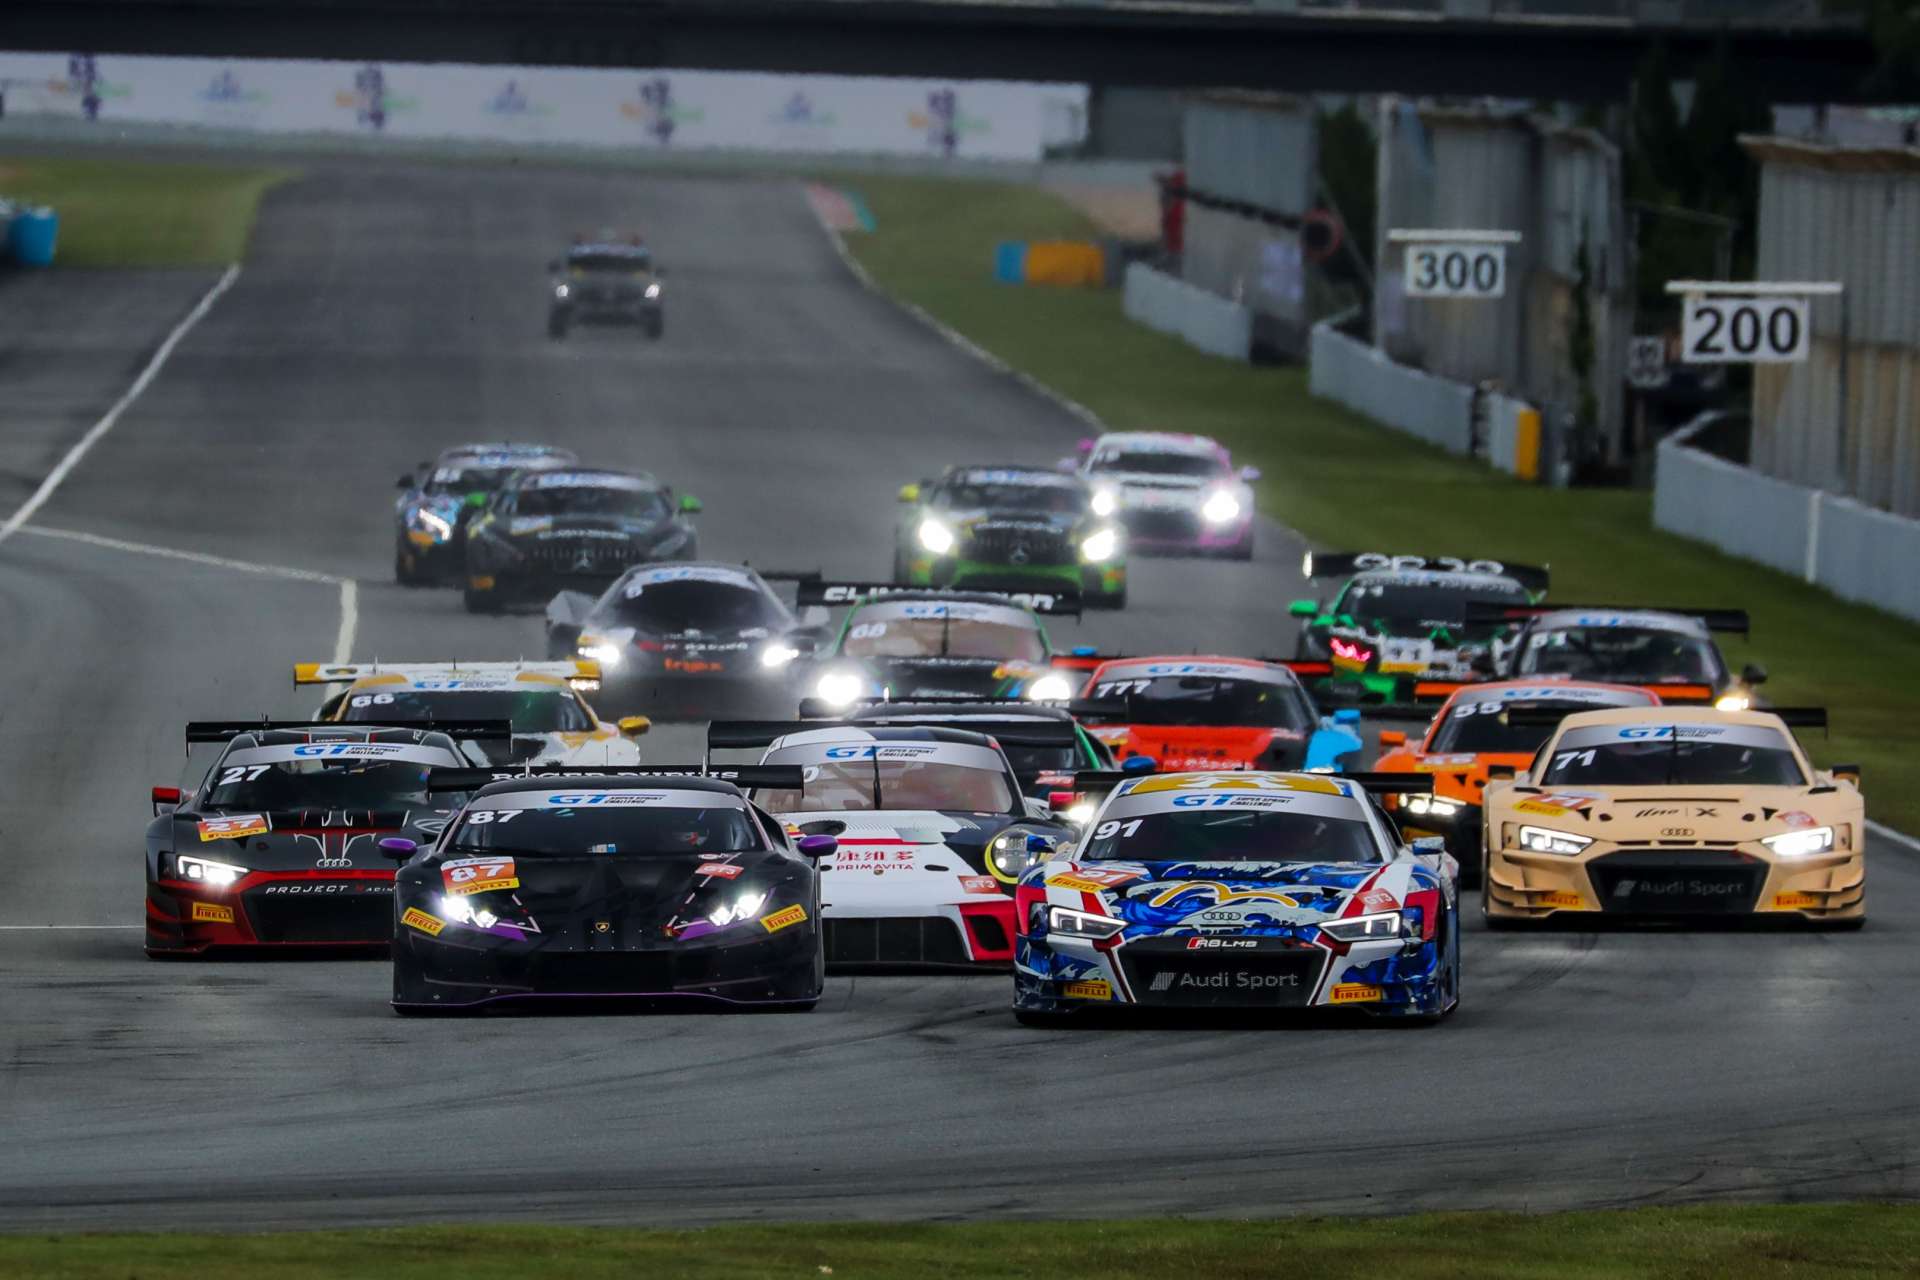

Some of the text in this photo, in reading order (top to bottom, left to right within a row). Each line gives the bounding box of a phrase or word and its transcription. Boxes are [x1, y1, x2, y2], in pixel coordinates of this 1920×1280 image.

[1415, 252, 1498, 291] 300
[1693, 307, 1800, 354] 200
[1097, 679, 1152, 698] 777
[351, 693, 395, 708] 66
[1454, 702, 1504, 719] 55
[1618, 726, 1675, 739] GT
[294, 743, 348, 757] GT
[825, 746, 880, 759] GT
[1555, 749, 1598, 770] 71
[218, 765, 267, 786] 27
[548, 794, 608, 805] GT
[1172, 793, 1233, 807] GT
[467, 809, 524, 825] 87
[1094, 819, 1144, 840] 91
[450, 864, 504, 882] 87
[265, 885, 348, 894] PROJECT
[406, 911, 442, 933] PIRELLI
[766, 909, 803, 930] PIRELLI
[1180, 971, 1299, 990] Audi Sport
[1333, 985, 1378, 1000] PIRELLI
